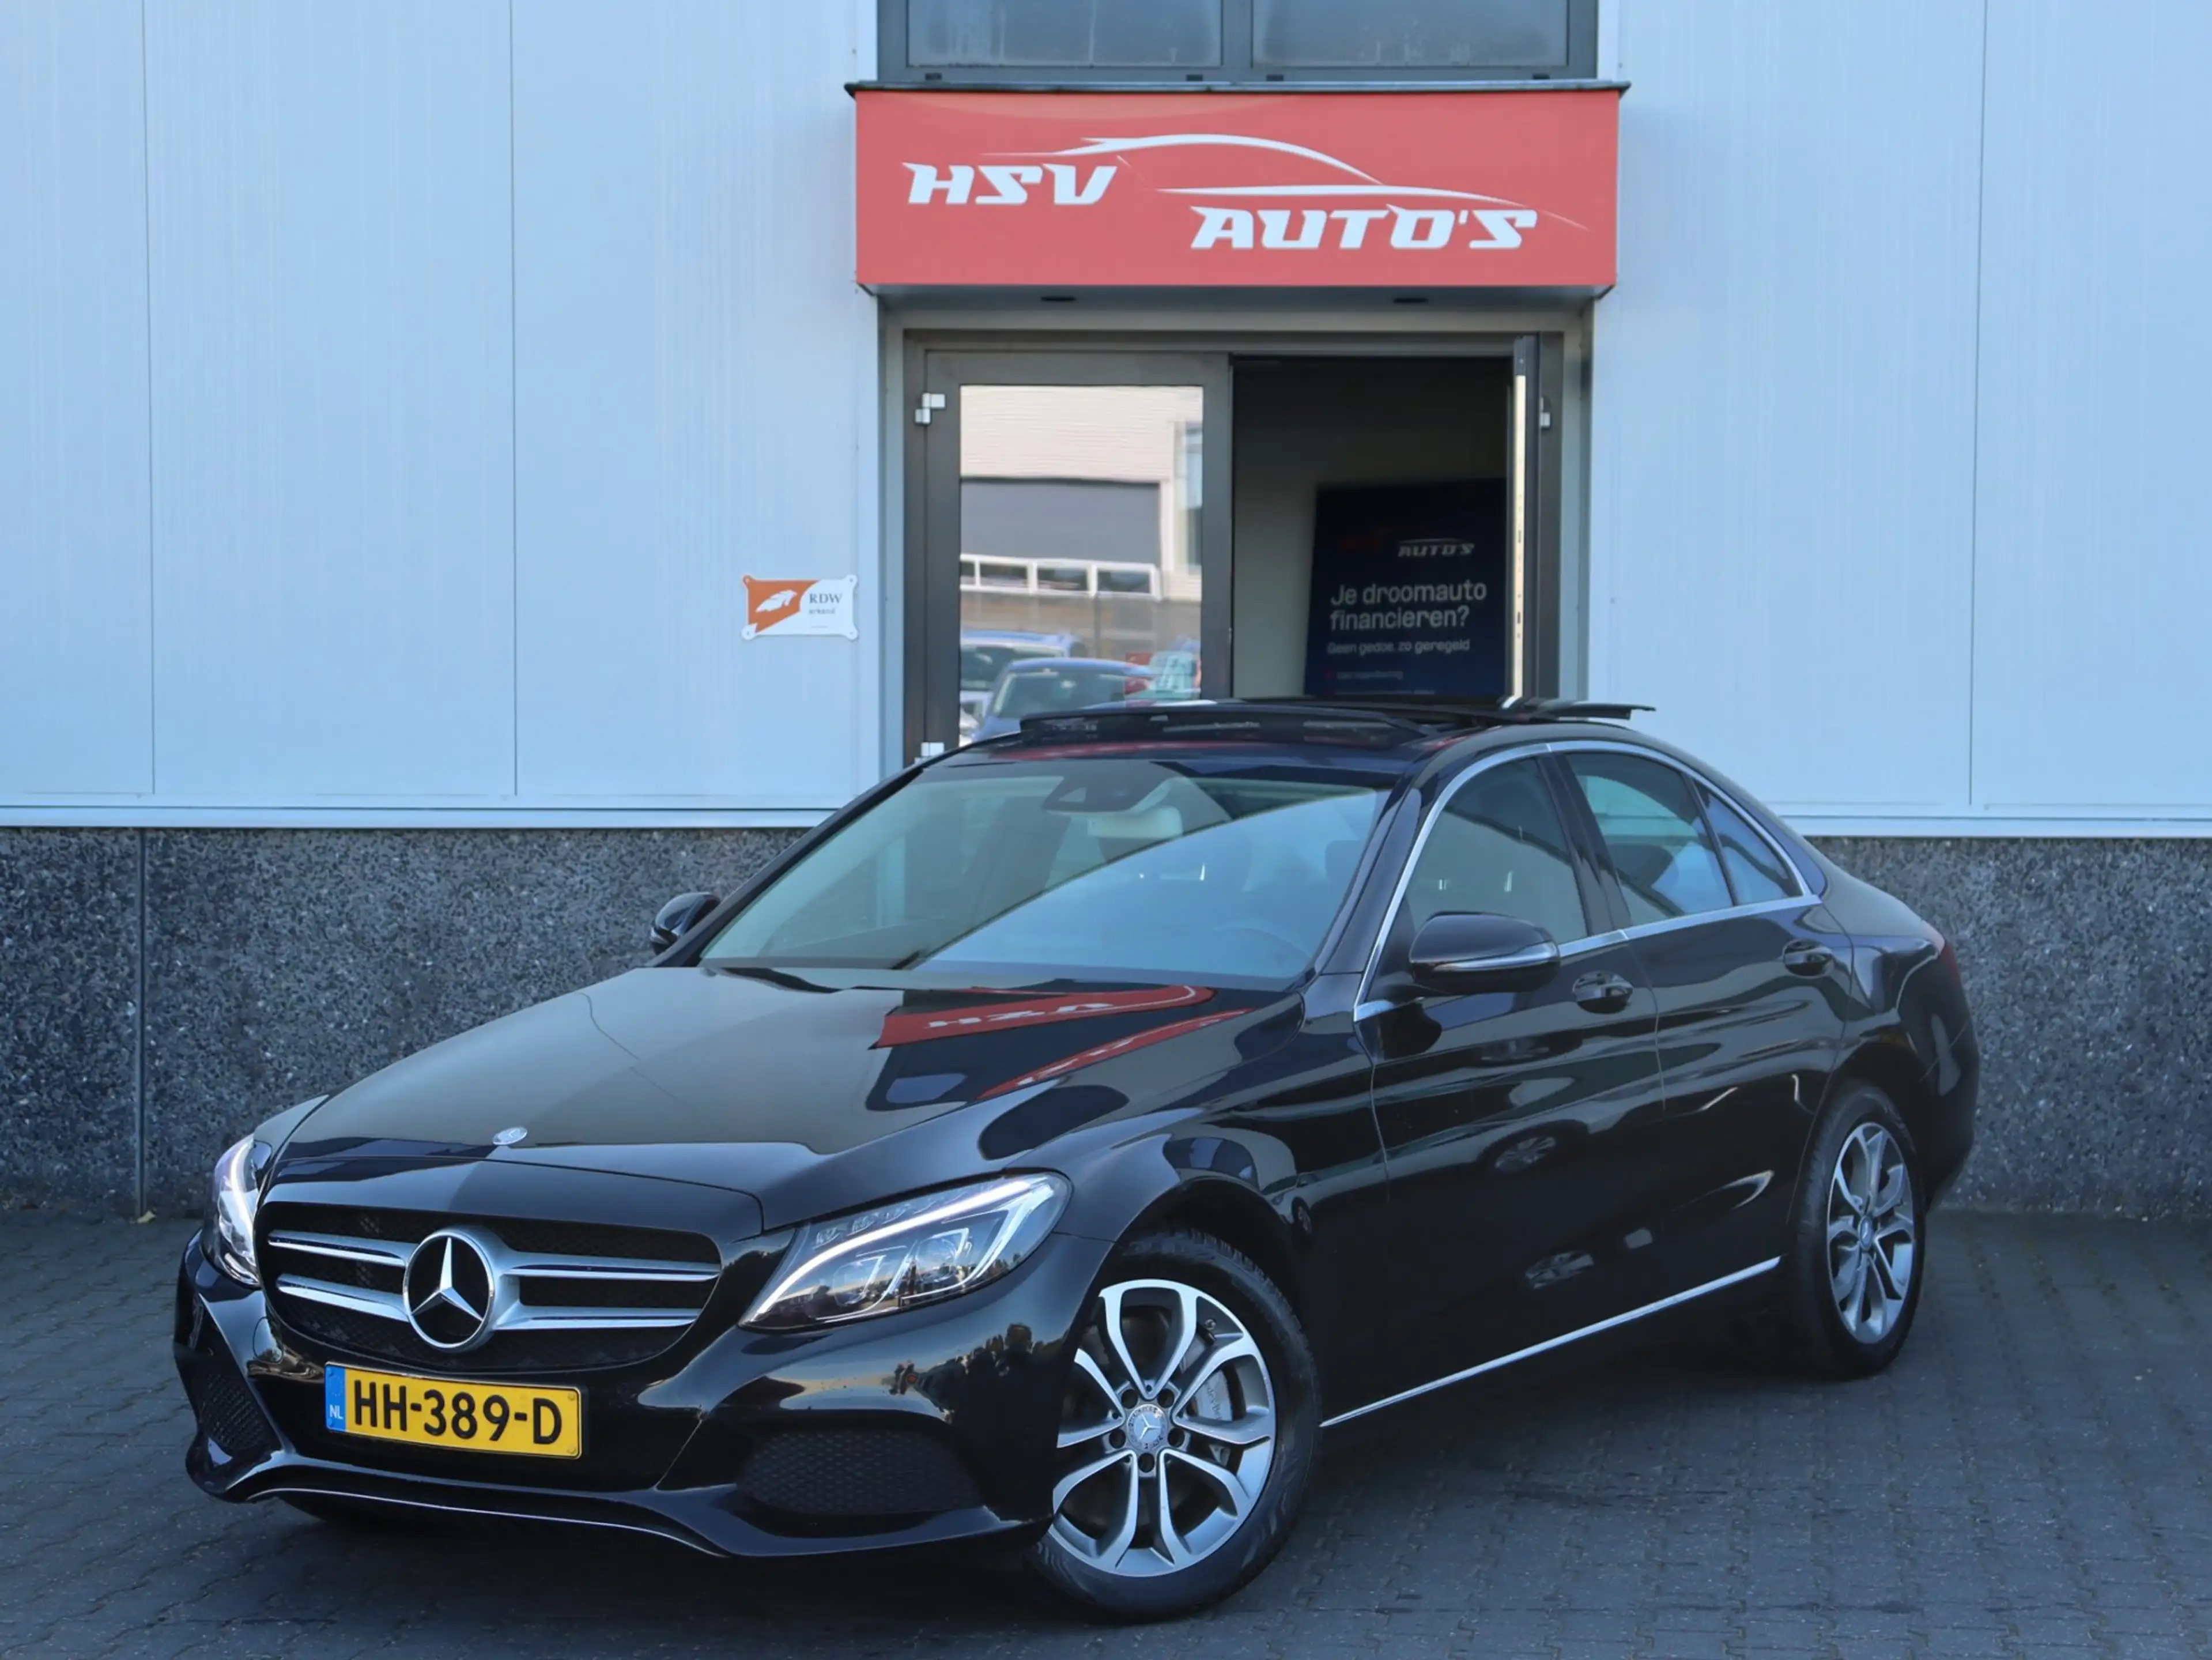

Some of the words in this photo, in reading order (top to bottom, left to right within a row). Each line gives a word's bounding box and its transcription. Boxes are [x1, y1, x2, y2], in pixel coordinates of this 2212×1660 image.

[902, 162, 1117, 205] HSV
[1190, 204, 1537, 249] AUTO'S
[809, 593, 843, 603] RDW
[1330, 584, 1357, 606] Je
[1362, 579, 1487, 605] droomauto
[1330, 605, 1470, 631] financieren?
[329, 1405, 343, 1420] NL
[354, 1380, 562, 1445] HH-389-D
